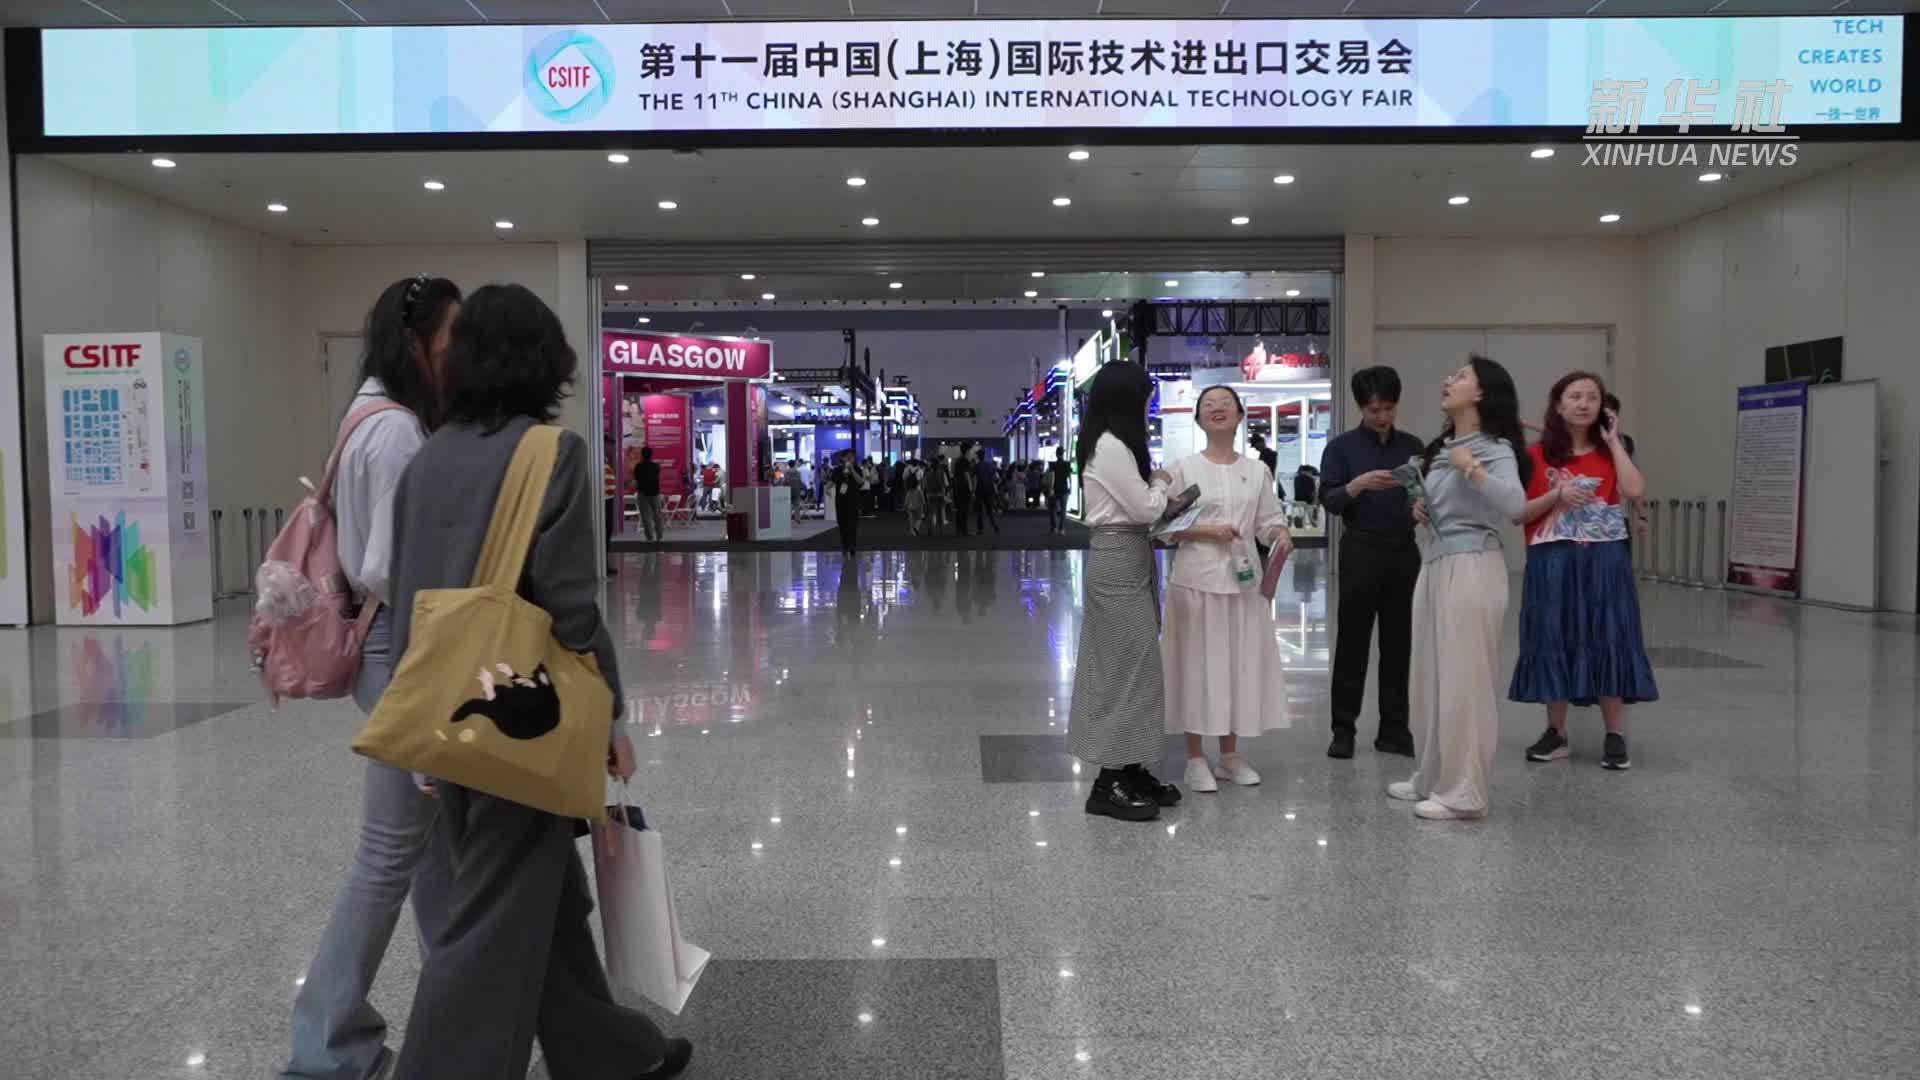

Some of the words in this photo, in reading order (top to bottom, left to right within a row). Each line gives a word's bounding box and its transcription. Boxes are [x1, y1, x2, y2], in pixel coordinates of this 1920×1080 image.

[1832, 19, 1884, 34] TECH
[639, 37, 1413, 81] 第十一届中国(上海)国际技术进出口交易会
[1798, 48, 1883, 65] CREATES
[548, 66, 590, 89] CSITF
[1810, 78, 1882, 94] WORLD
[638, 93, 684, 111] THE
[746, 92, 823, 110] CHINA
[832, 90, 976, 111] (SHANGHAI)
[985, 89, 1179, 109] INTERNATIONAL
[1186, 89, 1353, 108] TECHNOLOGY
[1362, 89, 1413, 107] FAIR
[63, 343, 142, 369] CSITF
[608, 339, 746, 372] GLASGOW
